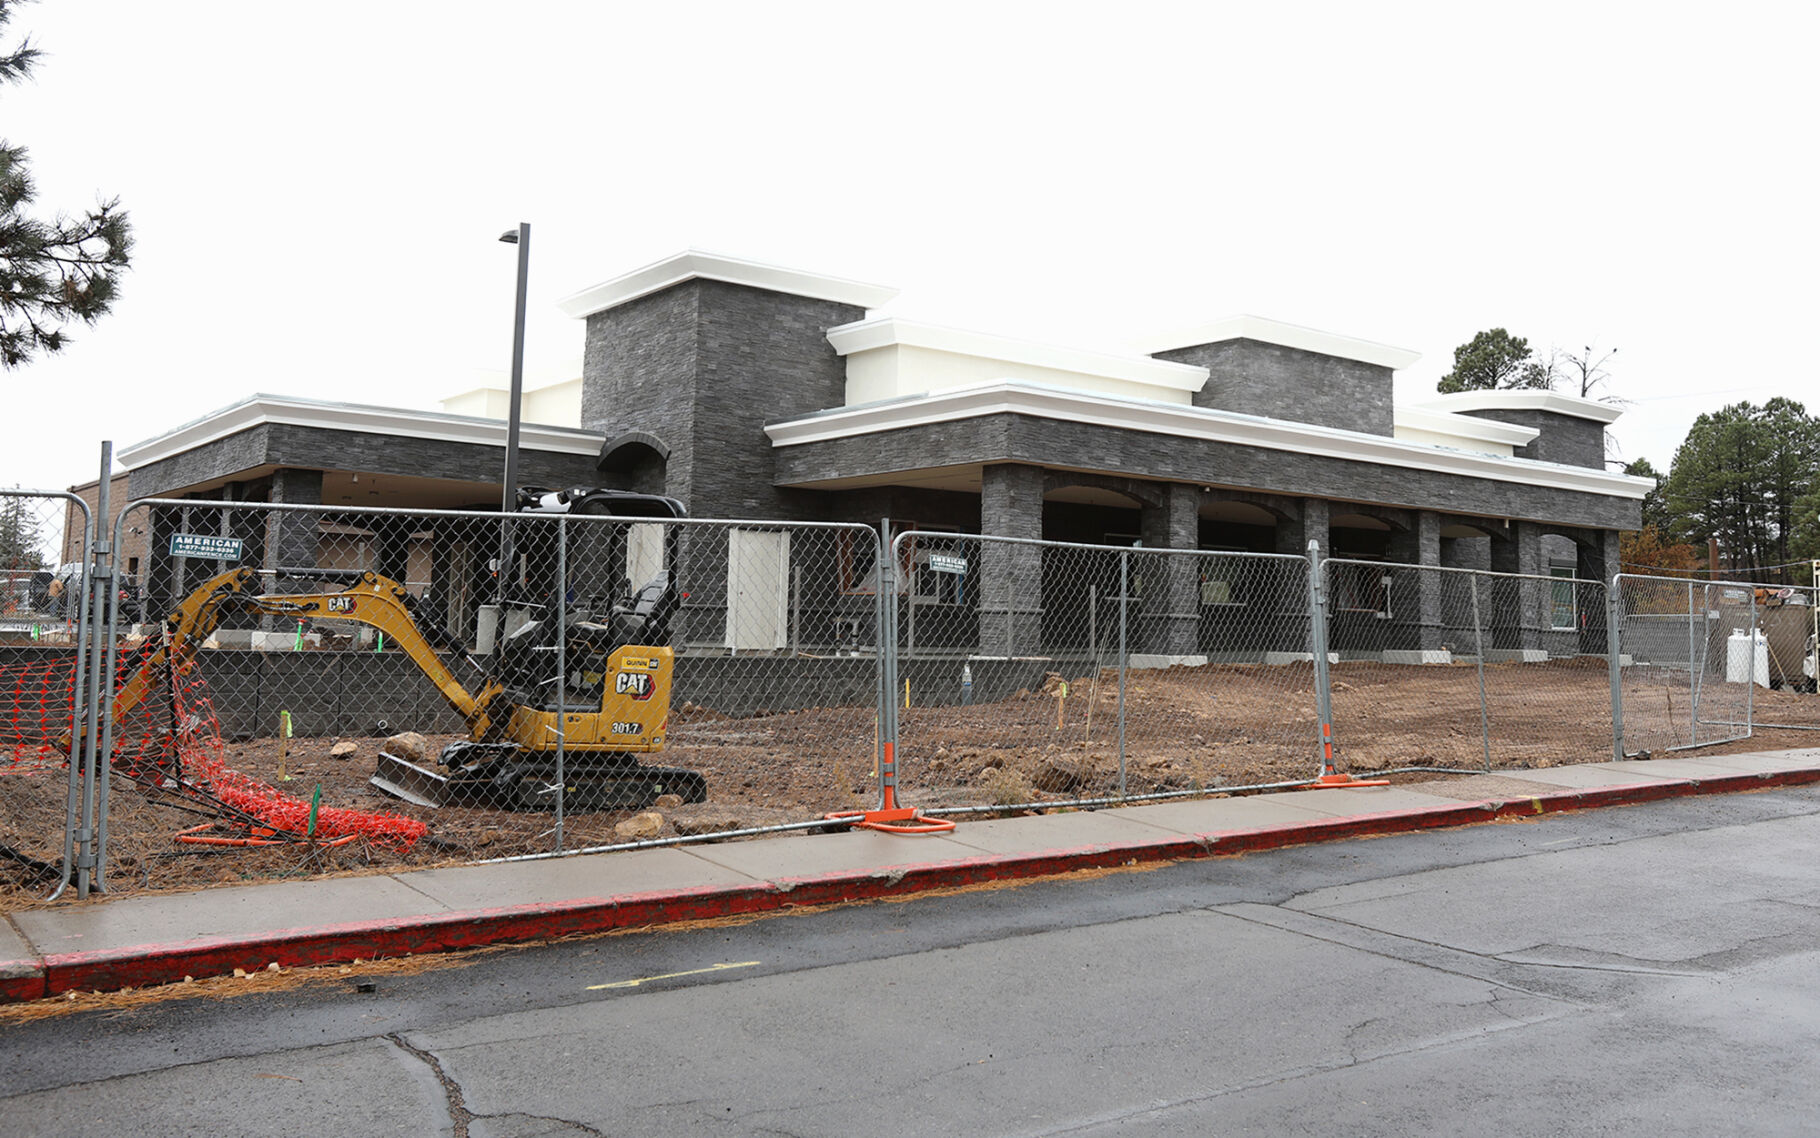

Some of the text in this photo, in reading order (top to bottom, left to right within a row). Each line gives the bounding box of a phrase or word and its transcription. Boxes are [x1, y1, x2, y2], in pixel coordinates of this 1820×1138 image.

[175, 537, 239, 548] AMERICAN
[932, 556, 966, 565] AMERICAN
[328, 597, 350, 611] CAT
[616, 673, 648, 694] CAT
[612, 722, 639, 734] 301.7
